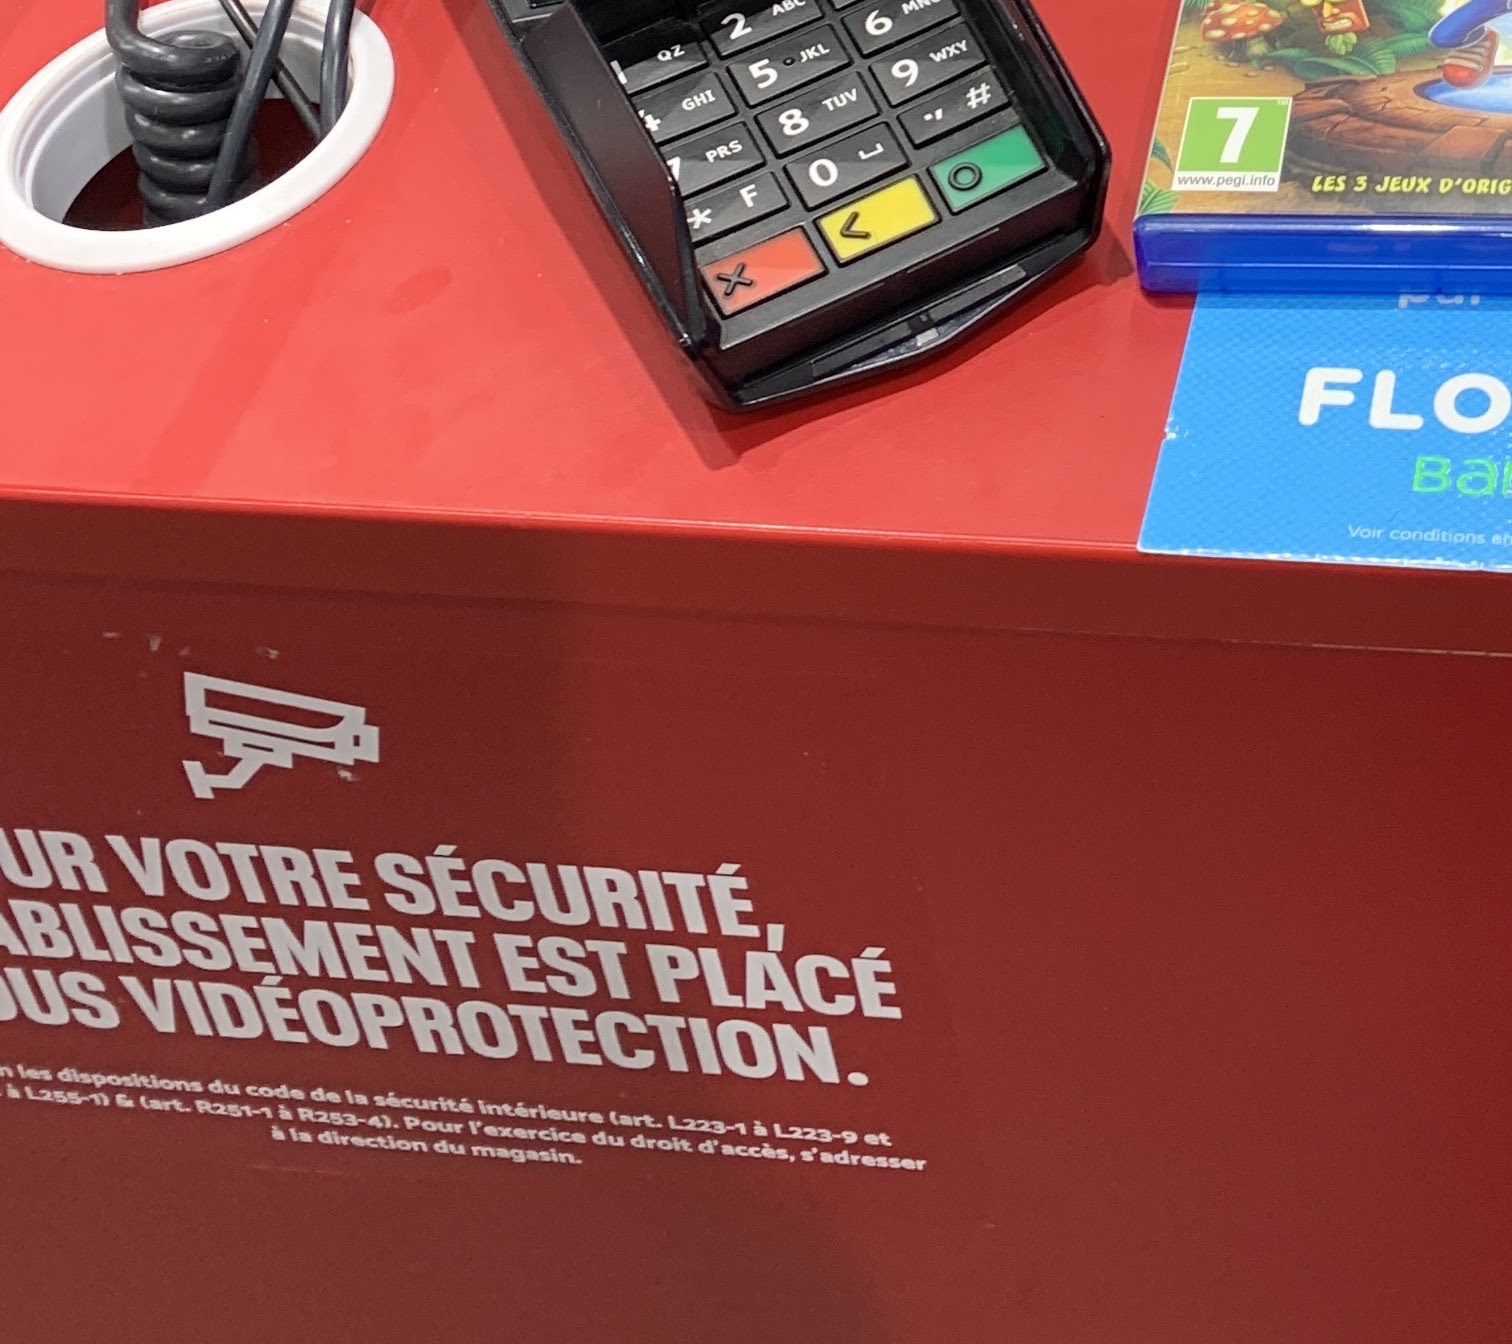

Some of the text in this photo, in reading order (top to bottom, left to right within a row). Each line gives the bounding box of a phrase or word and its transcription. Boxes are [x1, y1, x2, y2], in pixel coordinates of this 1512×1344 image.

[720, 12, 753, 40] 2
[865, 9, 893, 36] 6
[656, 44, 685, 62] QZ
[748, 43, 830, 89] 5 JKL
[891, 40, 968, 87] 9 WXY
[681, 89, 716, 111] GHI
[778, 88, 858, 136] 8 TUV
[705, 140, 743, 163] PRS
[1216, 106, 1260, 164] 7
[739, 184, 758, 207] F
[1177, 173, 1276, 188] www.pegi.info
[1312, 175, 1346, 193] LES
[1353, 175, 1368, 192] 3
[1375, 176, 1430, 193] JEUX
[1347, 524, 1386, 540] Voir
[1389, 528, 1486, 546] conditions
[105, 834, 370, 911] VOTRE
[374, 844, 785, 952] SÉCURITÉ,
[493, 932, 631, 1000] EST
[645, 946, 902, 1019] PLACÉ
[118, 975, 869, 1087] VIDÉOPROTECTION.
[16, 1063, 53, 1081] les
[57, 1066, 203, 1093] dispositions
[207, 1078, 241, 1096] du
[245, 1083, 305, 1100] code
[309, 1087, 342, 1104] de
[344, 1089, 369, 1106] la
[373, 1091, 475, 1114] sécurité
[477, 1099, 605, 1125] intérieure
[609, 1111, 663, 1129] (art.
[666, 1115, 748, 1136] L223-1
[753, 1119, 768, 1138] à
[773, 1123, 859, 1144] L223-9
[863, 1131, 893, 1147] et
[6, 1082, 21, 1100] à
[114, 1092, 136, 1109] &
[139, 1094, 192, 1113] (art.
[194, 1098, 274, 1120] R251-1
[277, 1104, 294, 1121] à
[297, 1106, 400, 1130] R253-4).
[402, 1115, 464, 1135] Pour
[468, 1120, 588, 1144] l'exercice
[591, 1127, 625, 1147] du
[629, 1133, 693, 1154] droit
[697, 1137, 797, 1164] d'accès,
[799, 1146, 928, 1172] s'adresser
[271, 1125, 583, 1165] à la direction du magasin.
